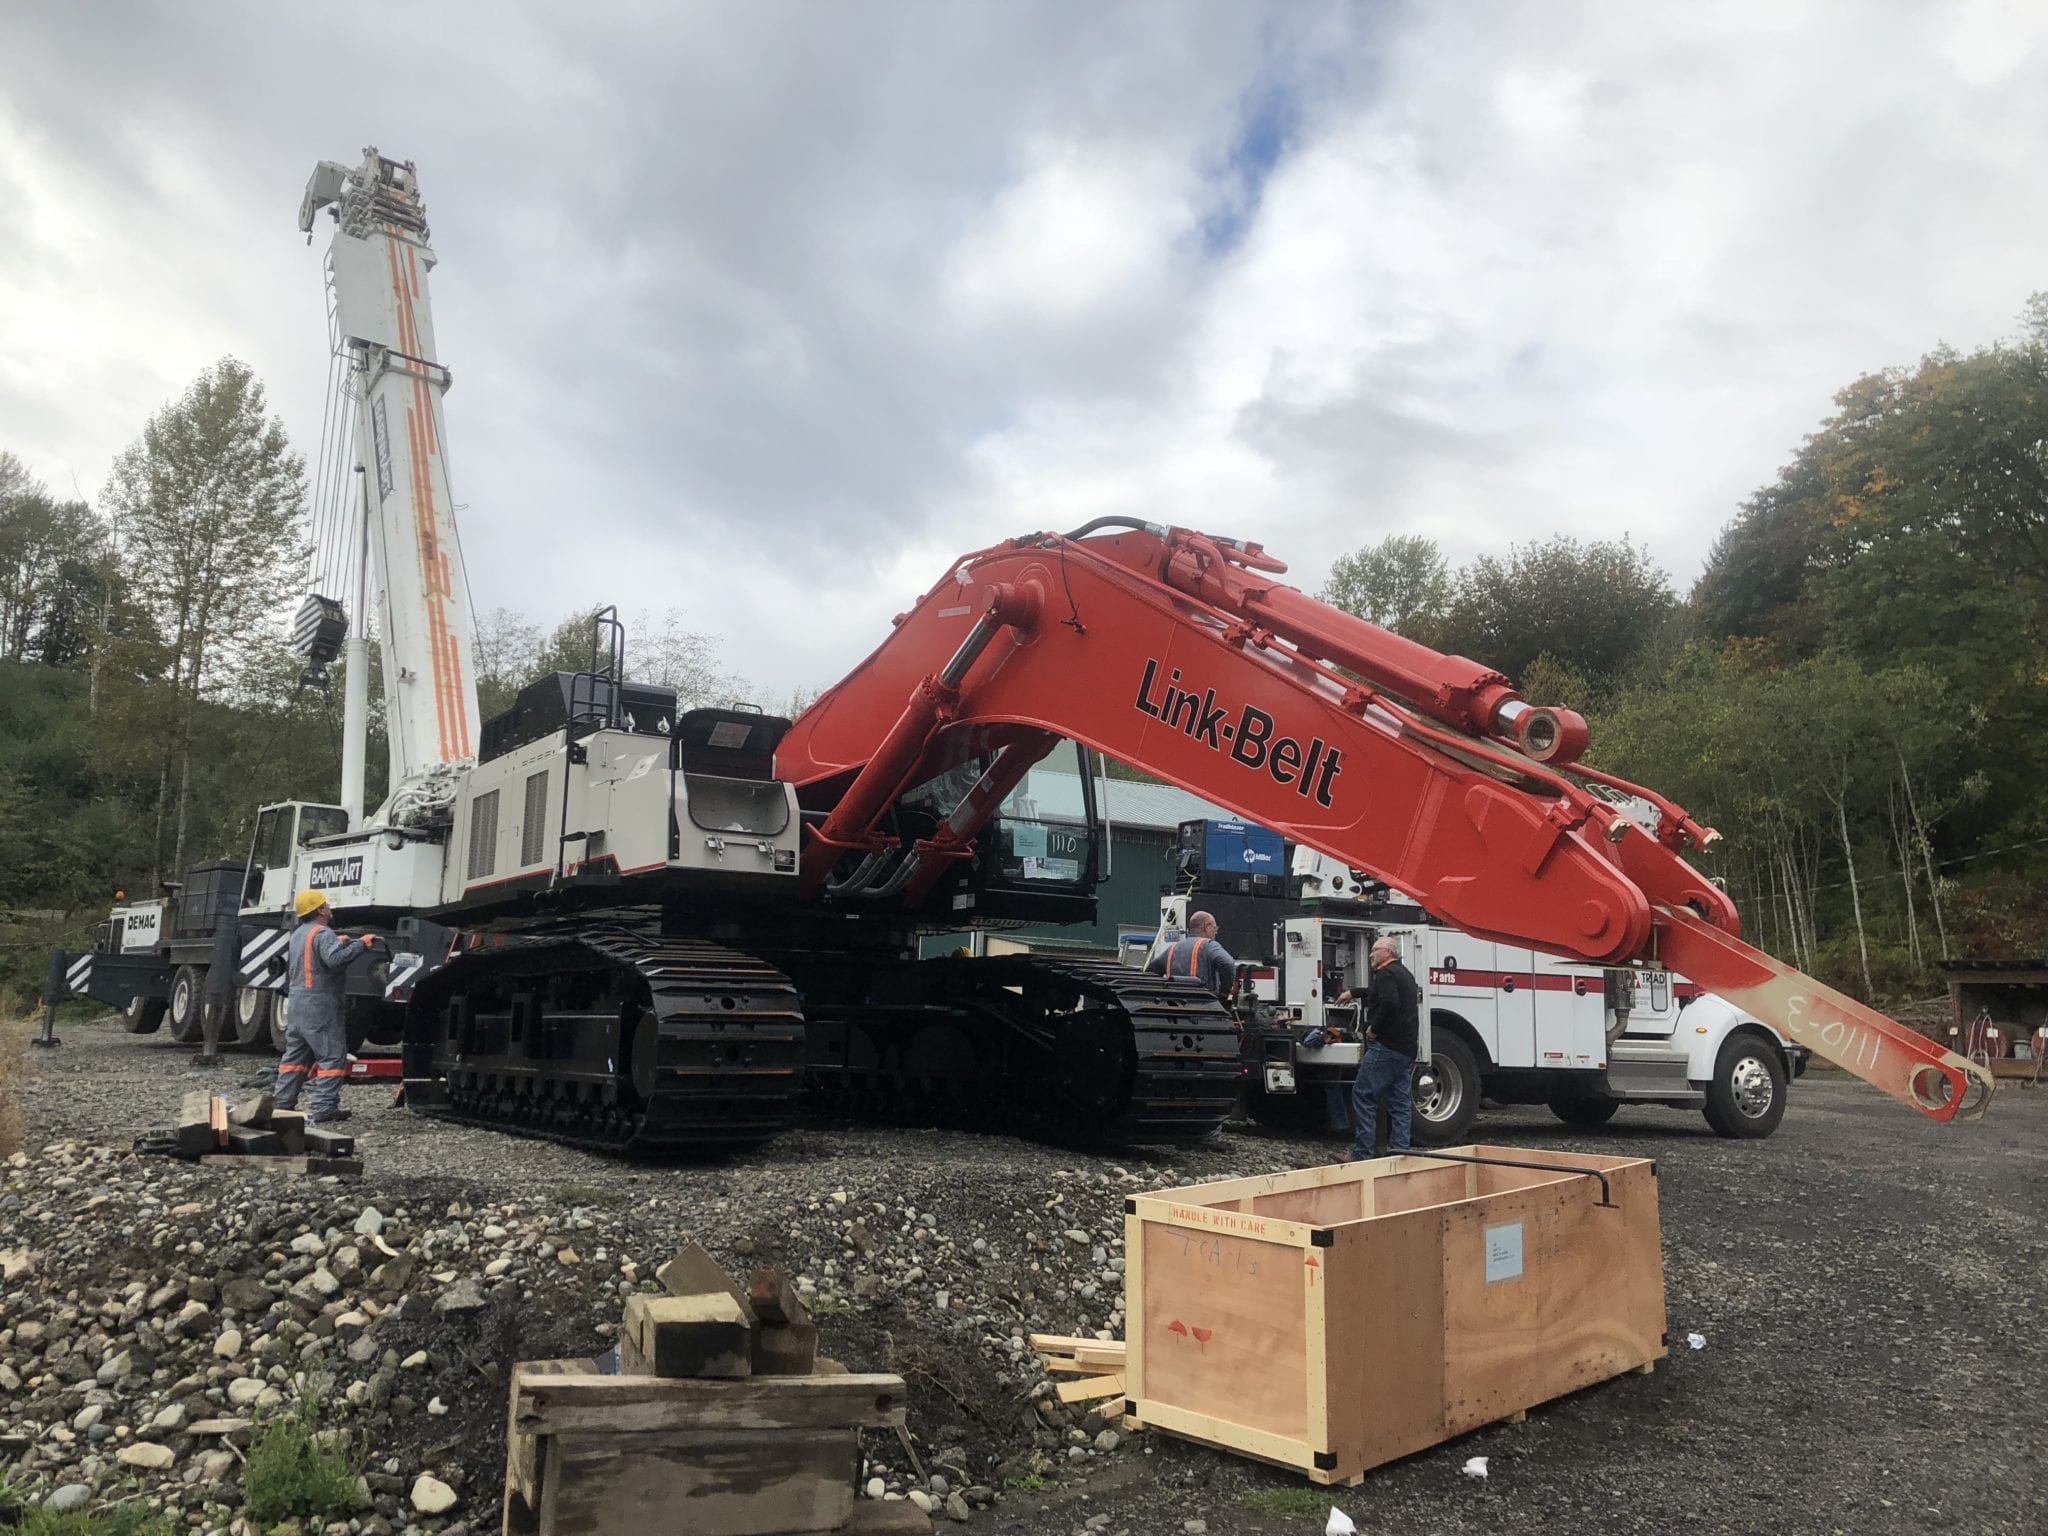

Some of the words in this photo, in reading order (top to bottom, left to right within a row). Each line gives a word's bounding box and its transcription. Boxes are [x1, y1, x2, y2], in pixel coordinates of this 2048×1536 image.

[1052, 834, 1077, 853] 1110
[311, 861, 362, 886] BARNHART
[128, 914, 156, 930] DEMAG
[1173, 1207, 1208, 1223] HANDLE
[1213, 1215, 1236, 1228] WITH
[1240, 1220, 1266, 1234] CARE
